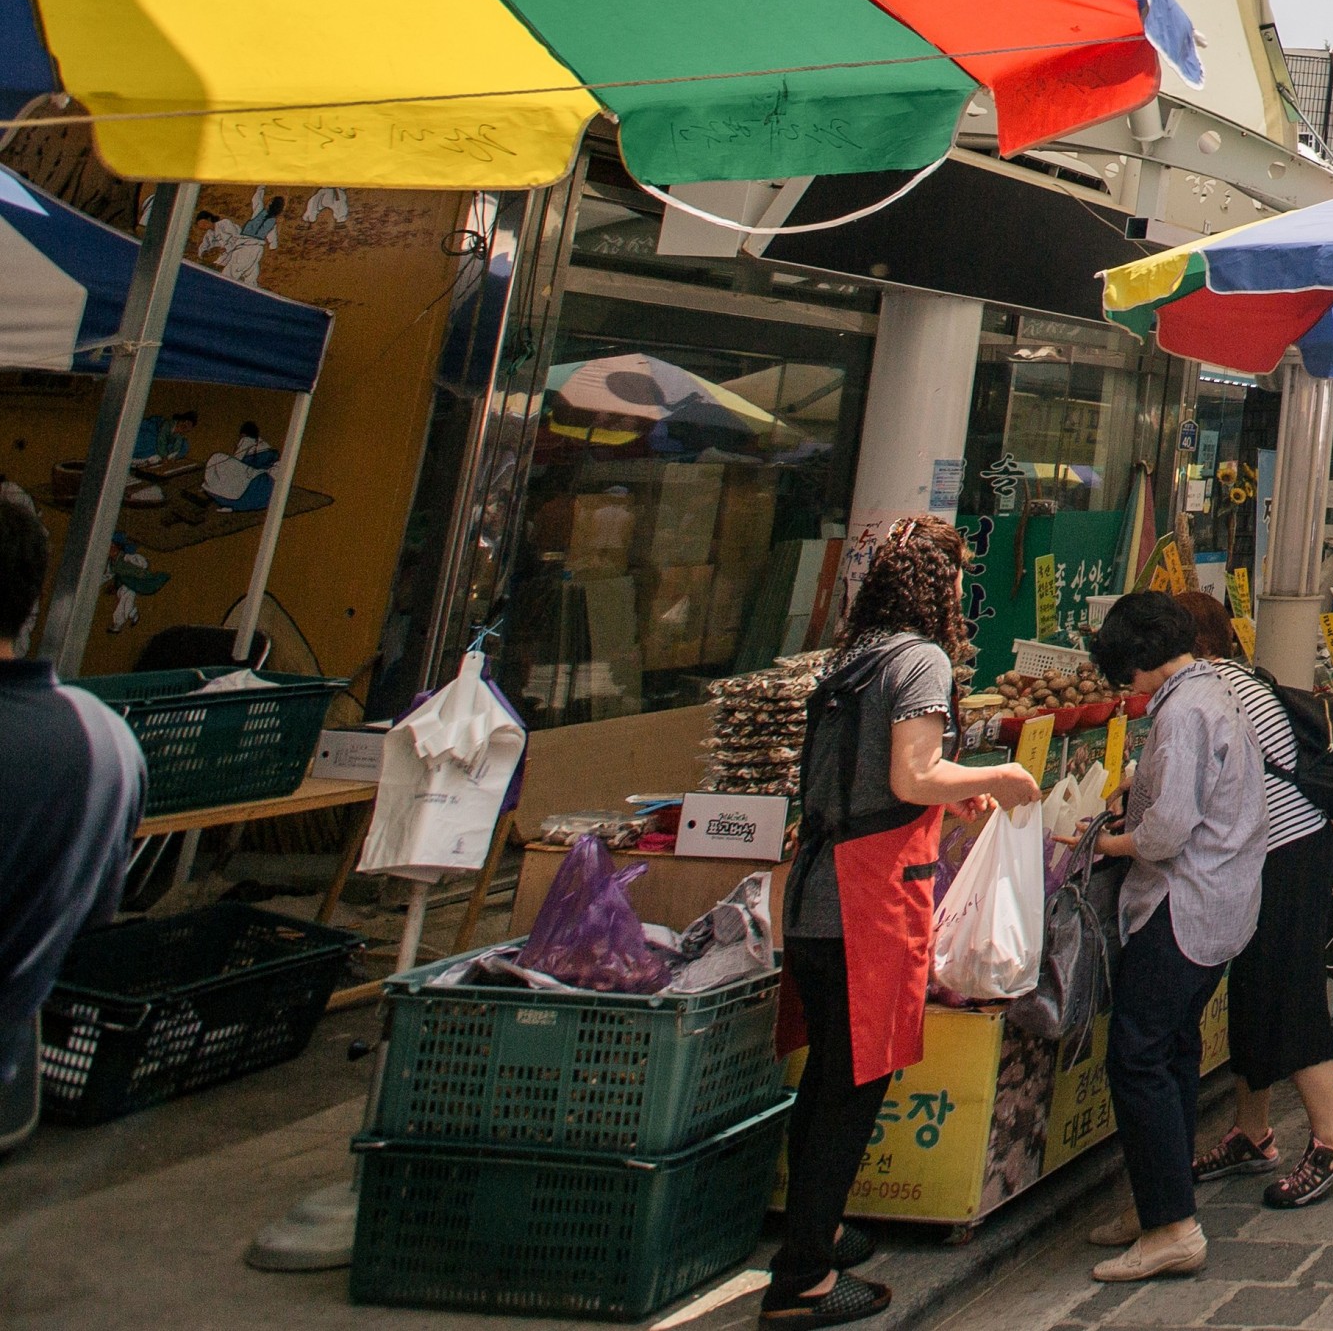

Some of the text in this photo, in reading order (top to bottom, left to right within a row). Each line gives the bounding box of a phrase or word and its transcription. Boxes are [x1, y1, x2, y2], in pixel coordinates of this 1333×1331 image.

[1182, 436, 1192, 448] 40
[706, 819, 756, 843] 표고버섯
[851, 1180, 923, 1201] 09-0956
